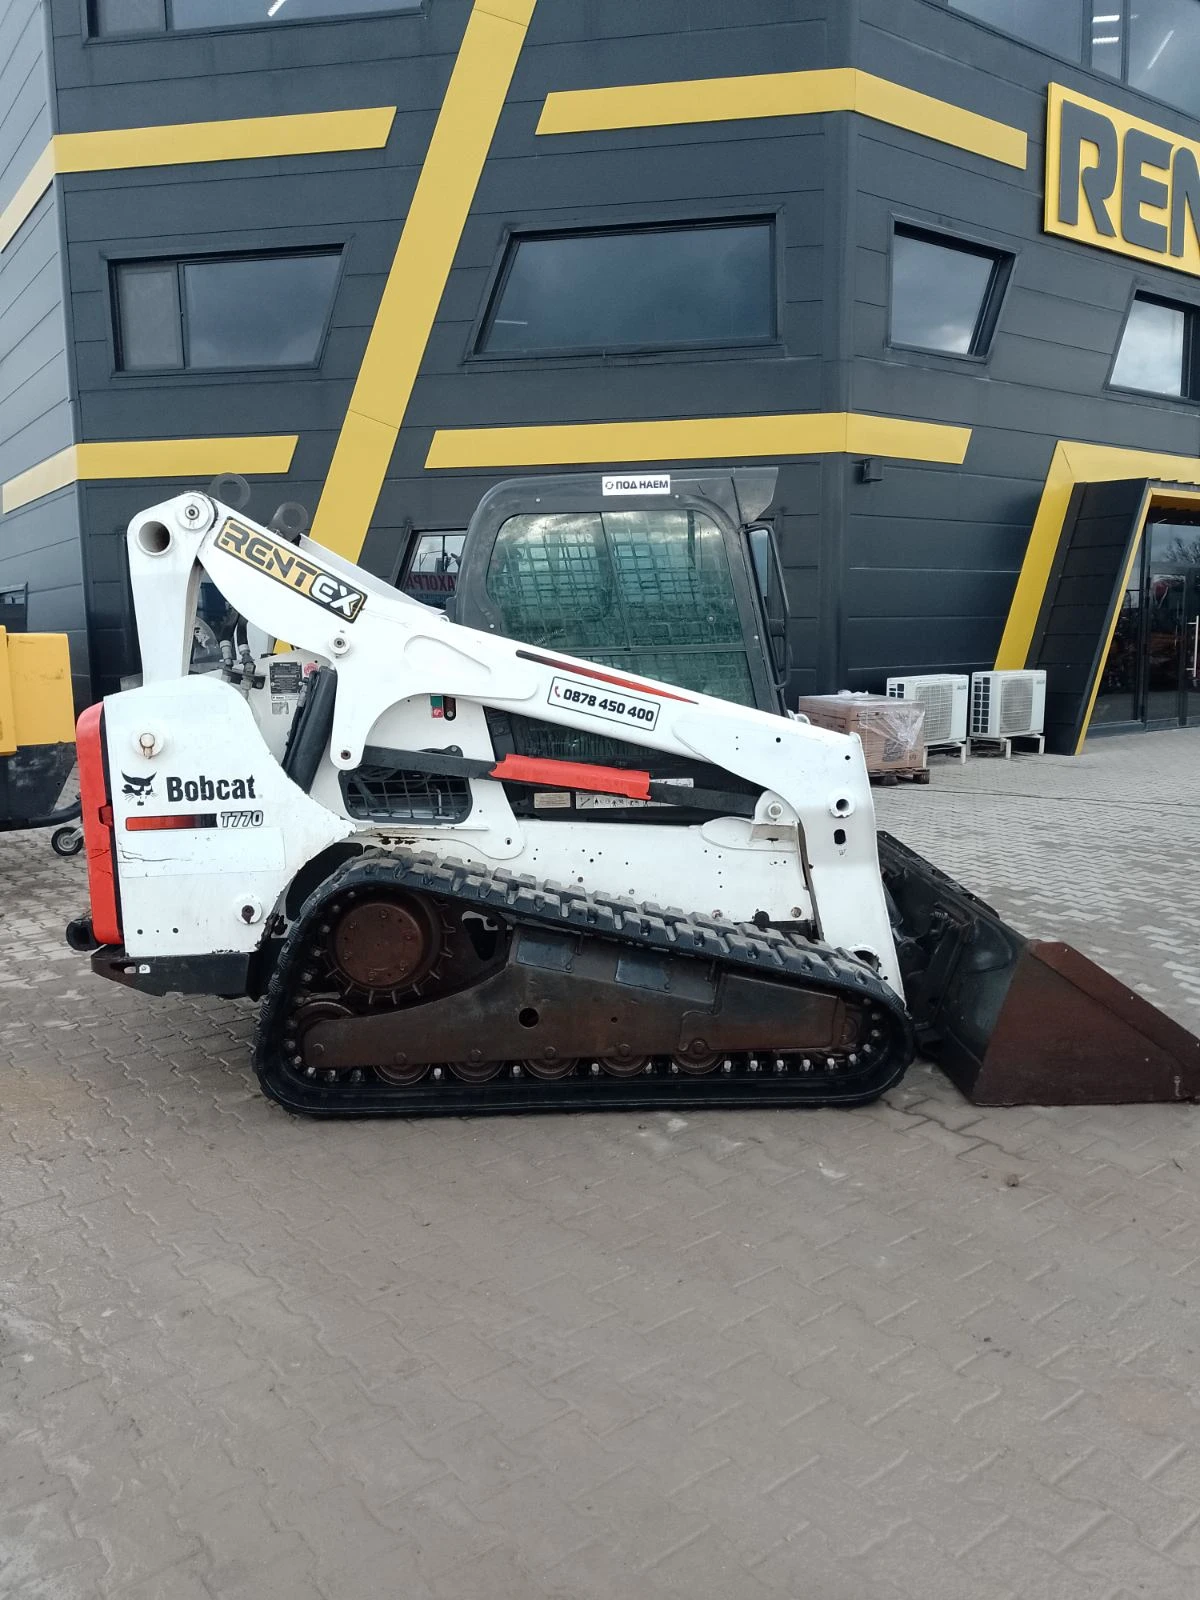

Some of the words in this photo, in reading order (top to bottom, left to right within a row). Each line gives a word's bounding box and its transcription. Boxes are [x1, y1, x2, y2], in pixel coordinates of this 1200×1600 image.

[615, 480, 637, 490] ПОД
[639, 480, 668, 489] НАЕМ
[221, 522, 361, 617] RENTEX
[563, 688, 597, 707] 0878
[598, 698, 626, 714] 450
[627, 706, 654, 722] 400
[166, 774, 256, 802] Bobcat
[220, 810, 264, 828] T770
